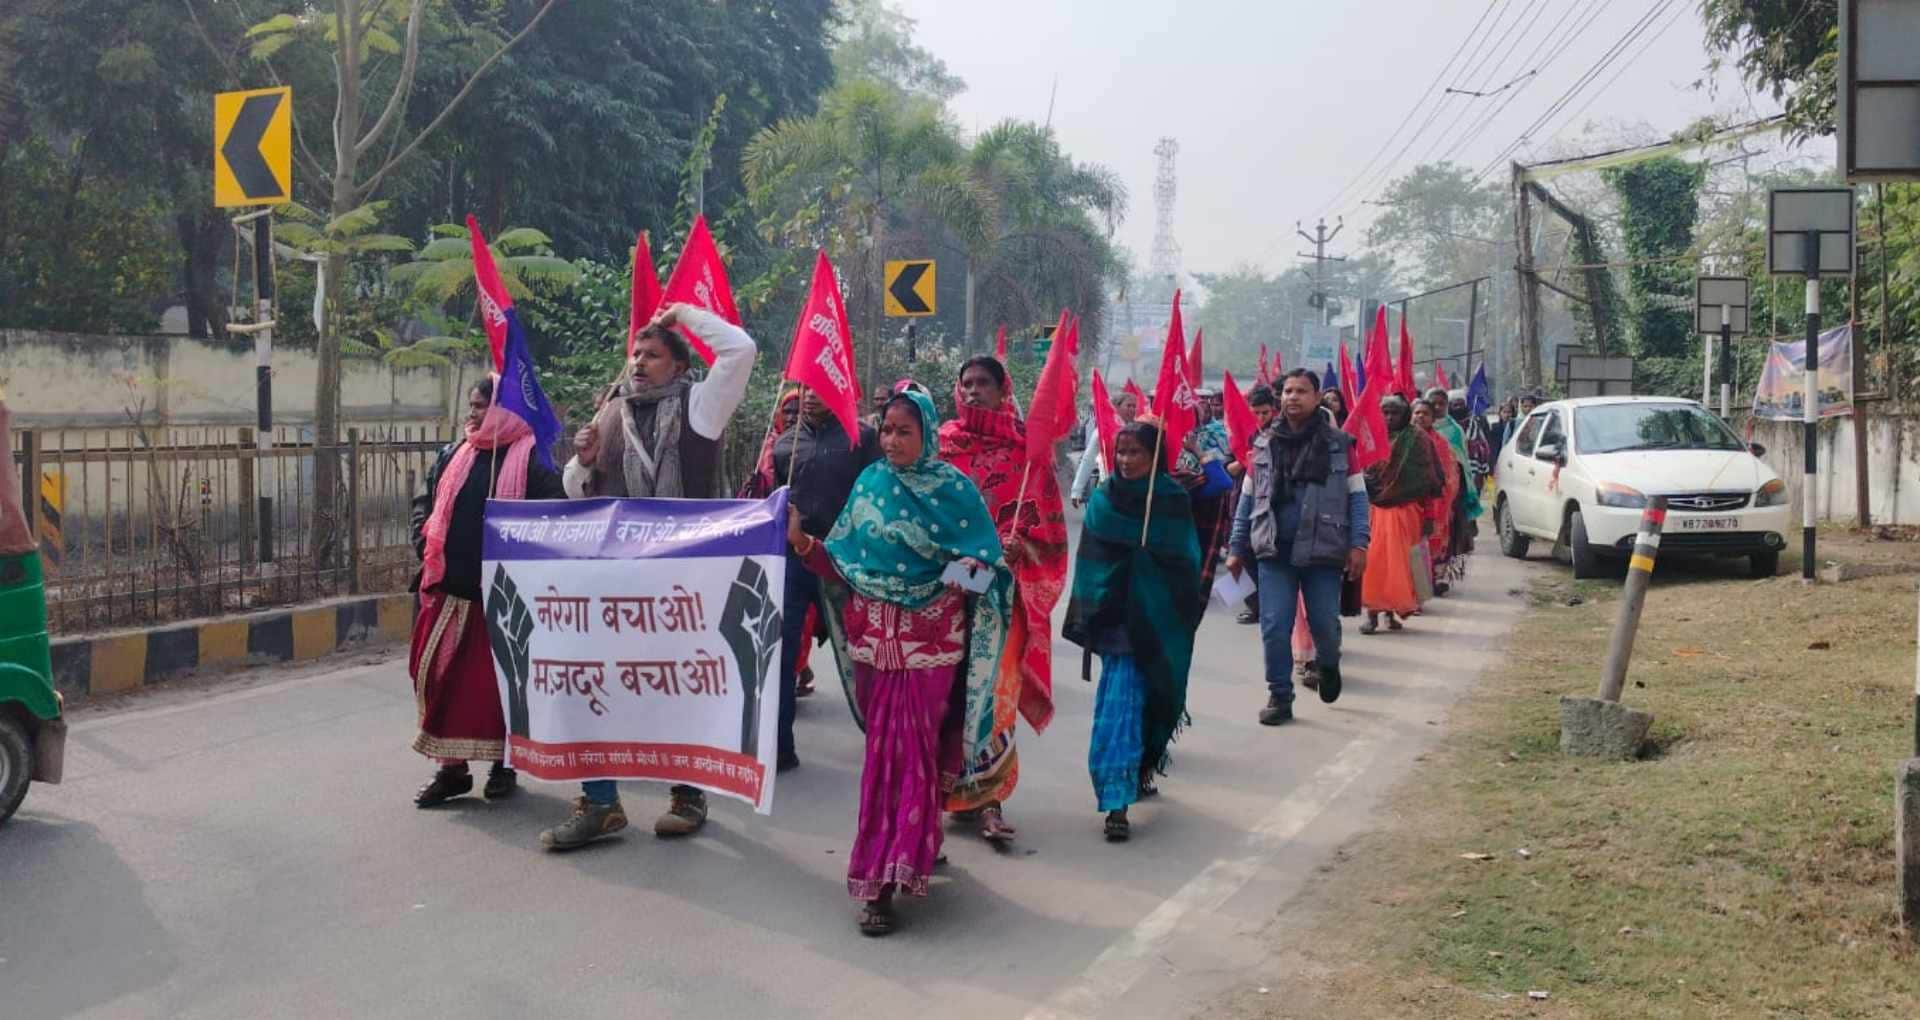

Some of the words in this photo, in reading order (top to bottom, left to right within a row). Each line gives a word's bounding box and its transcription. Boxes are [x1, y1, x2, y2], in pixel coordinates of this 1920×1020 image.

[498, 515, 549, 543] बचाओ
[534, 585, 591, 633] नरेगा
[600, 584, 705, 633] बचाओ!
[532, 659, 611, 716] मज़दूर
[616, 648, 728, 696] बचाओ!
